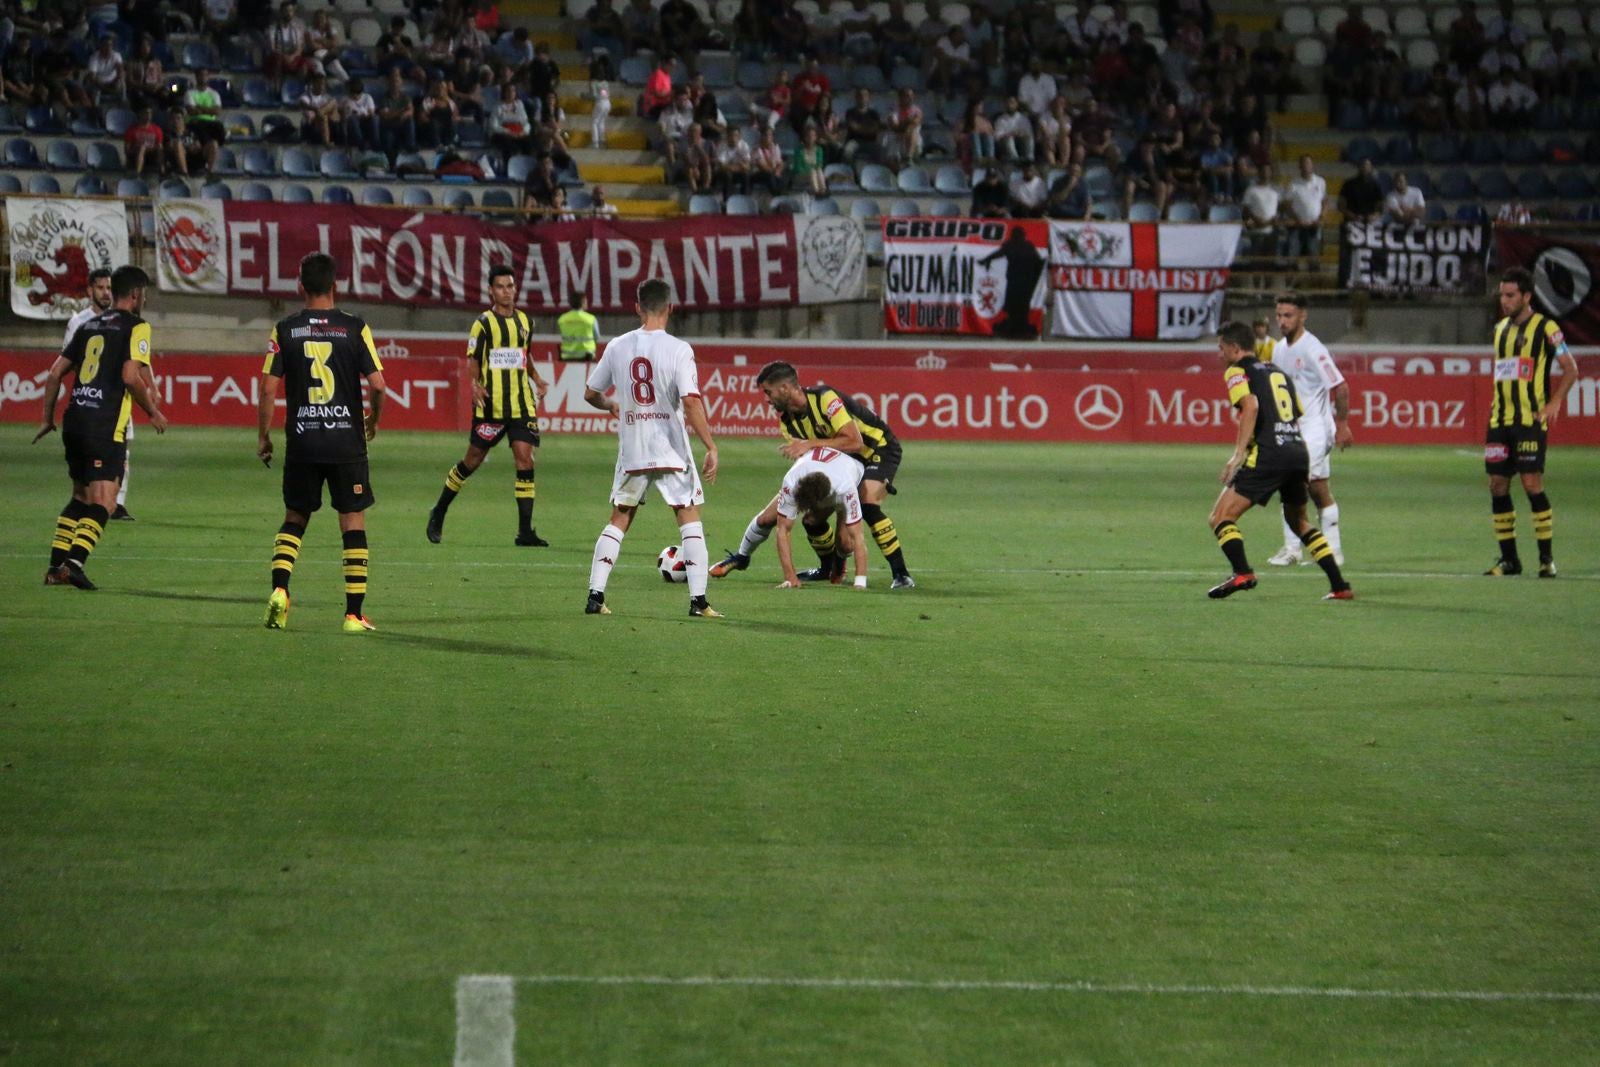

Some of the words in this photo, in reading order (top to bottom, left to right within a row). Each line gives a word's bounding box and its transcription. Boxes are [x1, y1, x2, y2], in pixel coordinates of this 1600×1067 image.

[35, 219, 84, 261] CULTURAL
[886, 221, 1004, 241] GRUPO
[228, 219, 298, 292] EL
[316, 212, 466, 302] LEÓN
[480, 230, 791, 308] RAMPANTE
[887, 246, 974, 295] GUZMÁN
[79, 334, 104, 384] 8
[304, 341, 335, 404] 3
[630, 357, 656, 406] 8
[1270, 371, 1294, 422] 6
